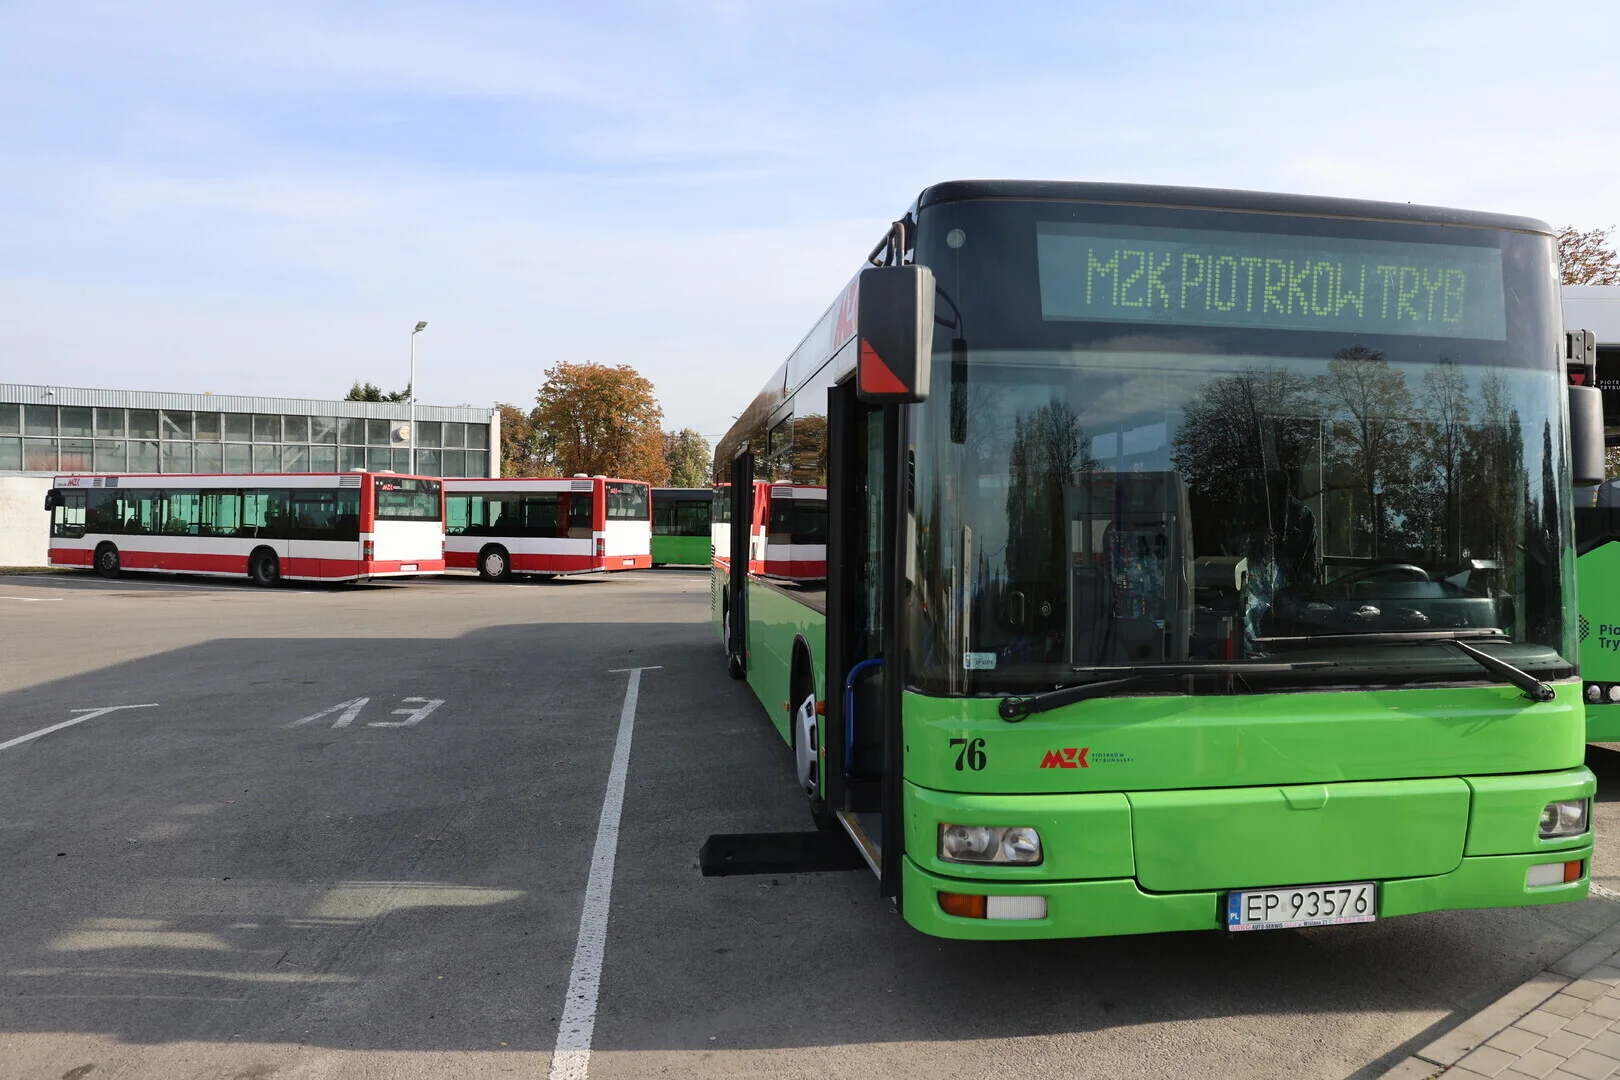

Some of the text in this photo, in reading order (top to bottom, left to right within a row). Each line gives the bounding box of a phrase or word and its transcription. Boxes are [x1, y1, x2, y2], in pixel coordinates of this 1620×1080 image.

[1086, 247, 1171, 308] MZK
[1377, 264, 1468, 323] TRYB
[833, 278, 859, 350] MZ
[949, 737, 987, 771] 76
[1039, 747, 1090, 769] MZK
[1230, 912, 1239, 920] PL
[1247, 887, 1368, 921] EP 93576
